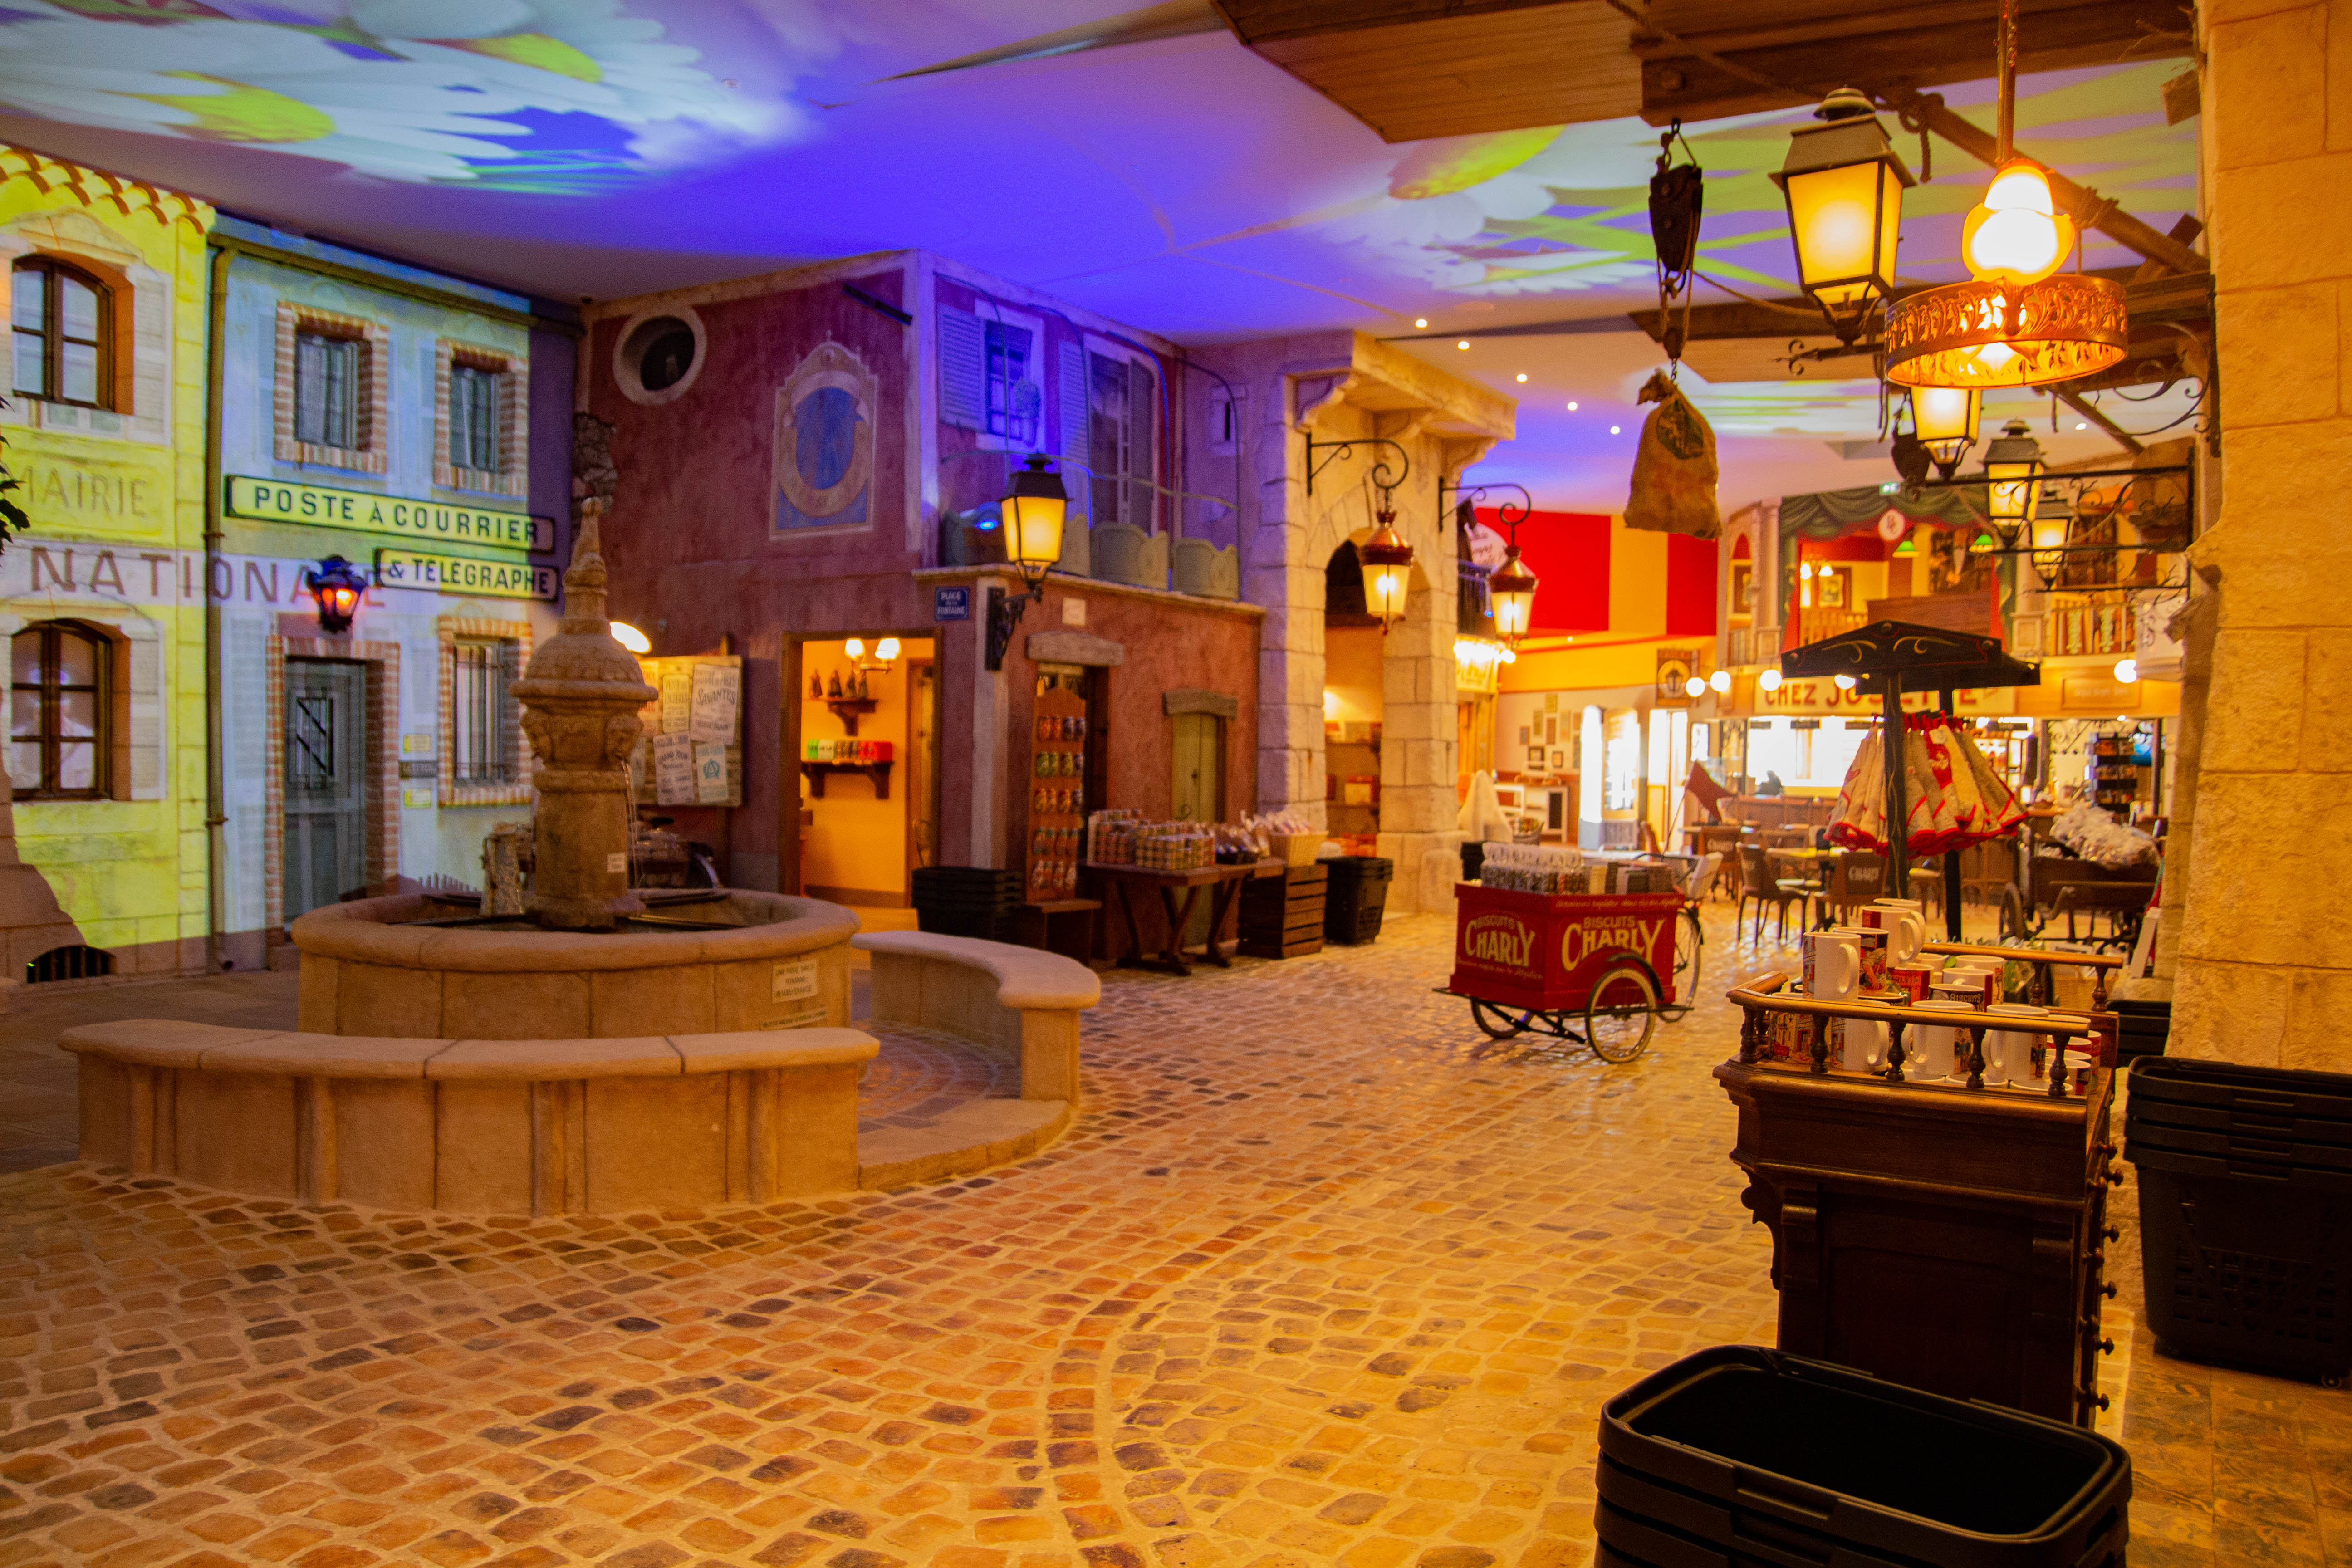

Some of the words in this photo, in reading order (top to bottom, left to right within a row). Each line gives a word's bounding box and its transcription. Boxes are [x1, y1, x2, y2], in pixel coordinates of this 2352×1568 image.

[255, 485, 354, 520] POSTE
[393, 504, 538, 543] COURRIER
[31, 546, 385, 607] NATIONAE
[388, 560, 405, 579] &
[941, 591, 961, 600] PLACE
[937, 606, 965, 615] FONTAINE
[1764, 683, 1817, 705] CHEZ
[1583, 915, 1636, 928] BISCUITS
[1465, 920, 1536, 967] CHARLY
[1561, 919, 1665, 972] CHARLY
